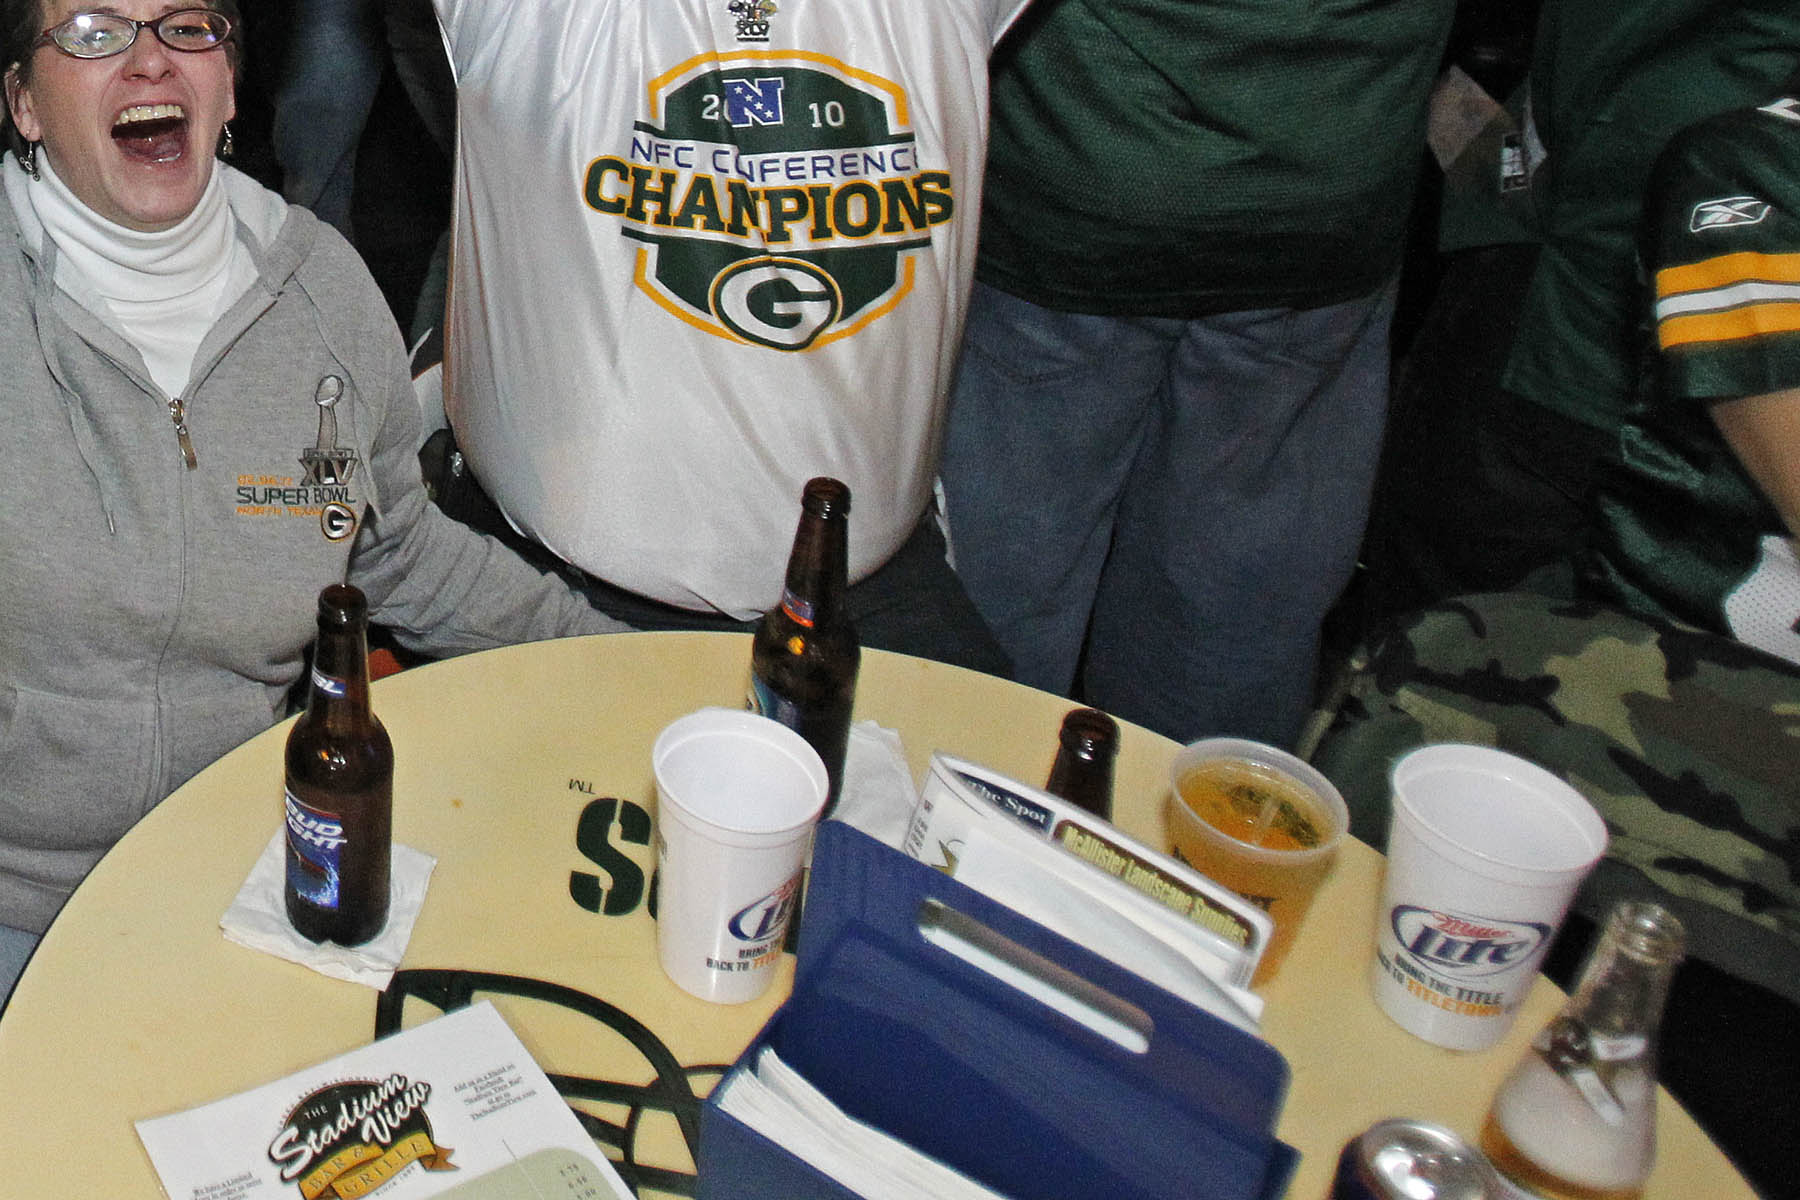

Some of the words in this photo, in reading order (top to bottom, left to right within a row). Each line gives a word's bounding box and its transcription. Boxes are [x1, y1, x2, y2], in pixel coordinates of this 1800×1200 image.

[810, 101, 845, 128] 10
[631, 136, 694, 171] NFC
[709, 256, 843, 353] G
[298, 458, 358, 487] XLV
[236, 506, 282, 518] NORTH
[237, 486, 309, 506] SUPER
[313, 486, 357, 504] BOWL
[320, 502, 357, 541] G
[285, 796, 344, 838] BUD
[1005, 796, 1048, 825] Spot
[568, 796, 659, 921] S
[1407, 922, 1532, 966] Lite
[706, 957, 734, 973] BACK
[736, 960, 750, 972] TO
[1455, 986, 1505, 1005] TITLE
[268, 1072, 407, 1182] Stadium
[304, 1105, 329, 1120] THE
[360, 1081, 433, 1144] View
[308, 1154, 346, 1191] BAR
[342, 1141, 427, 1195] GRILLE
